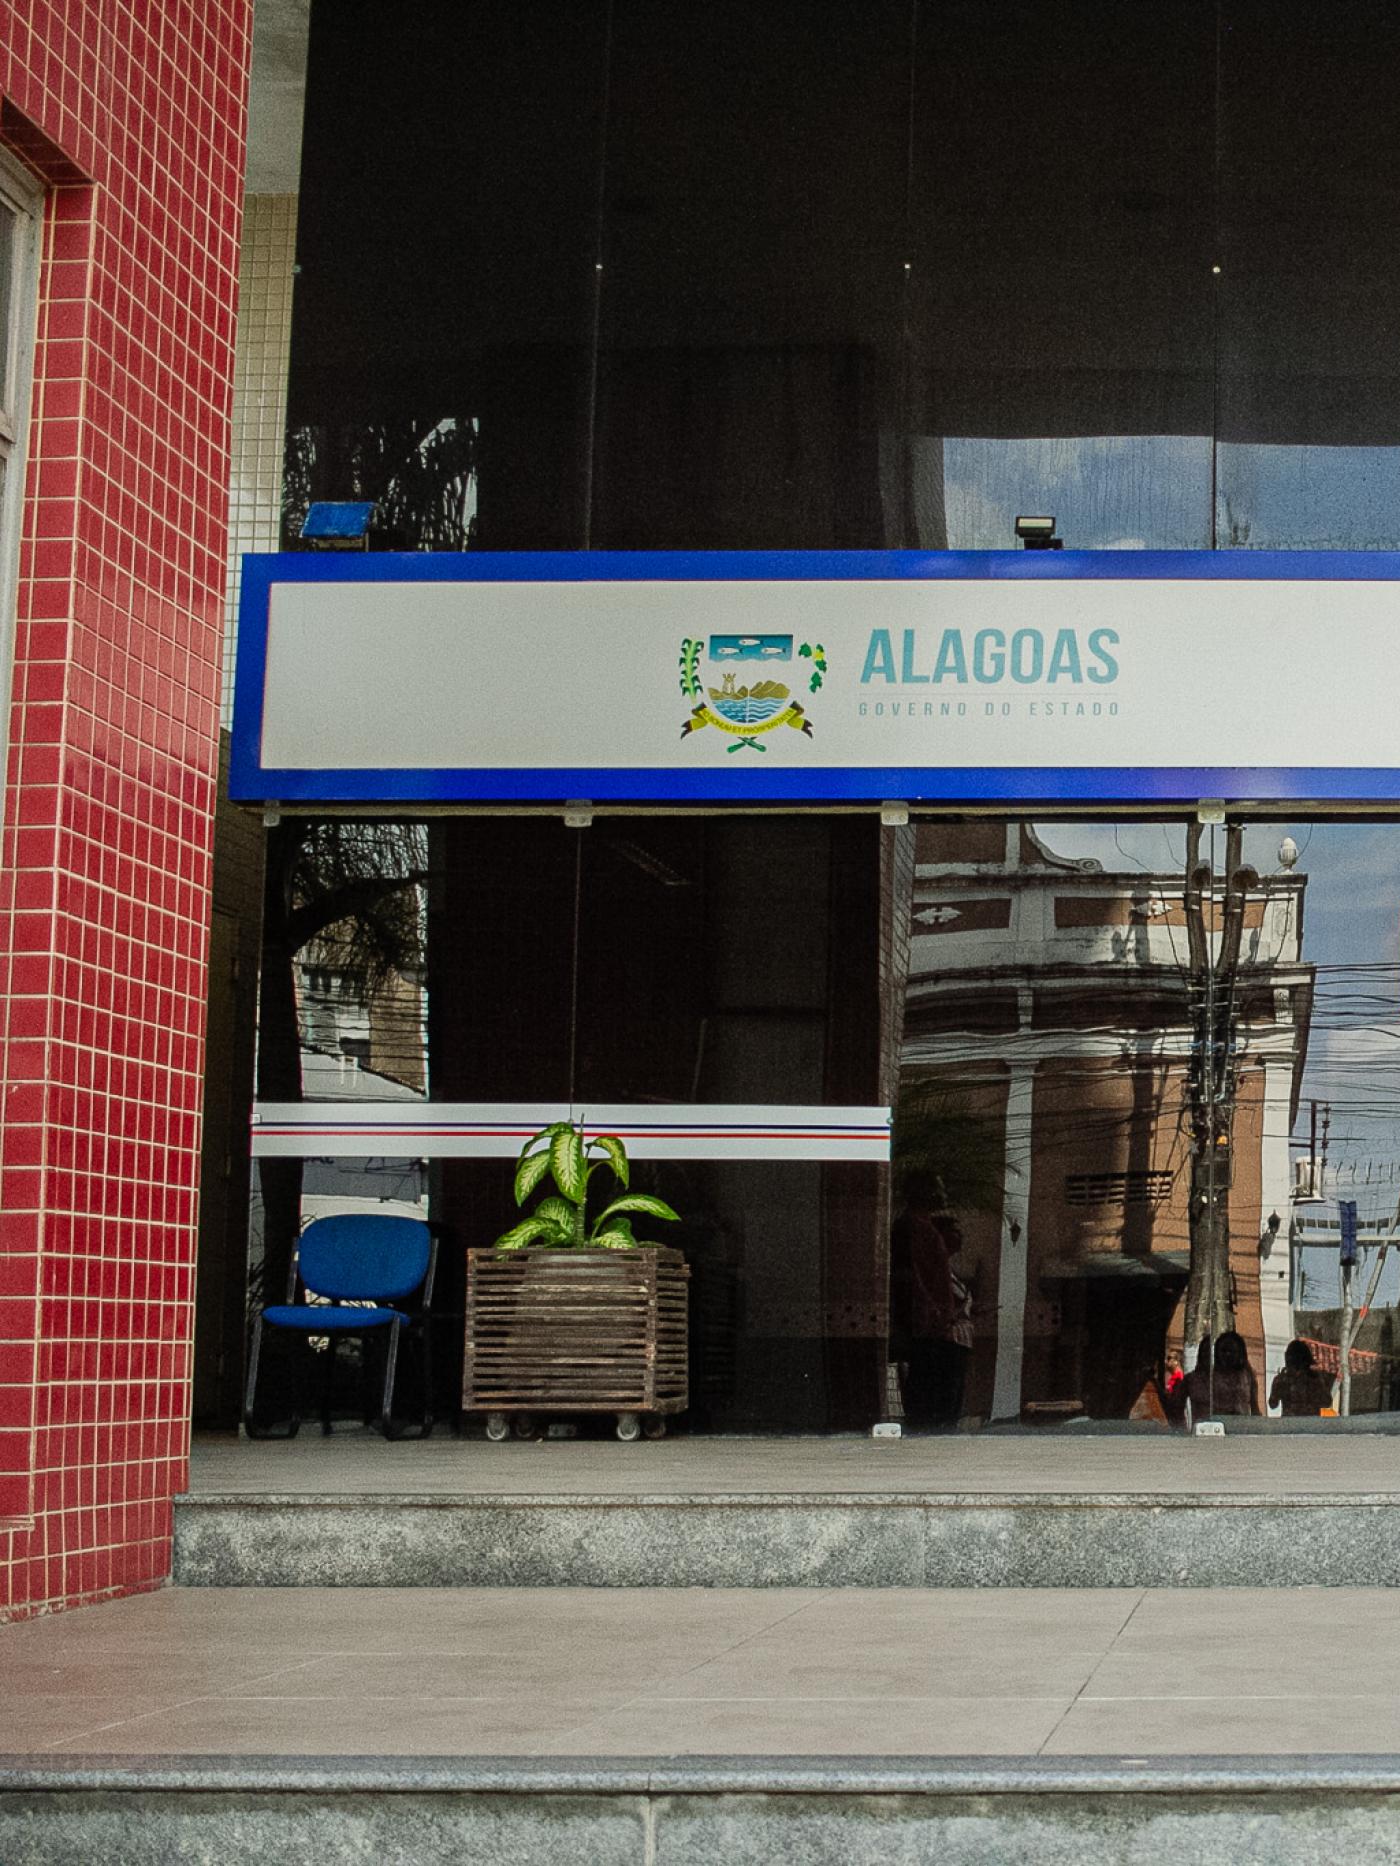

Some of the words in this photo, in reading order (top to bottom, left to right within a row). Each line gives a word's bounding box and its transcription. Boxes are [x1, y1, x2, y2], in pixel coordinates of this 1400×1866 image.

[859, 627, 1120, 685] ALAGOAS
[858, 702, 966, 716] GOVERNO
[984, 702, 1011, 716] DO
[1029, 702, 1119, 716] ESTADO
